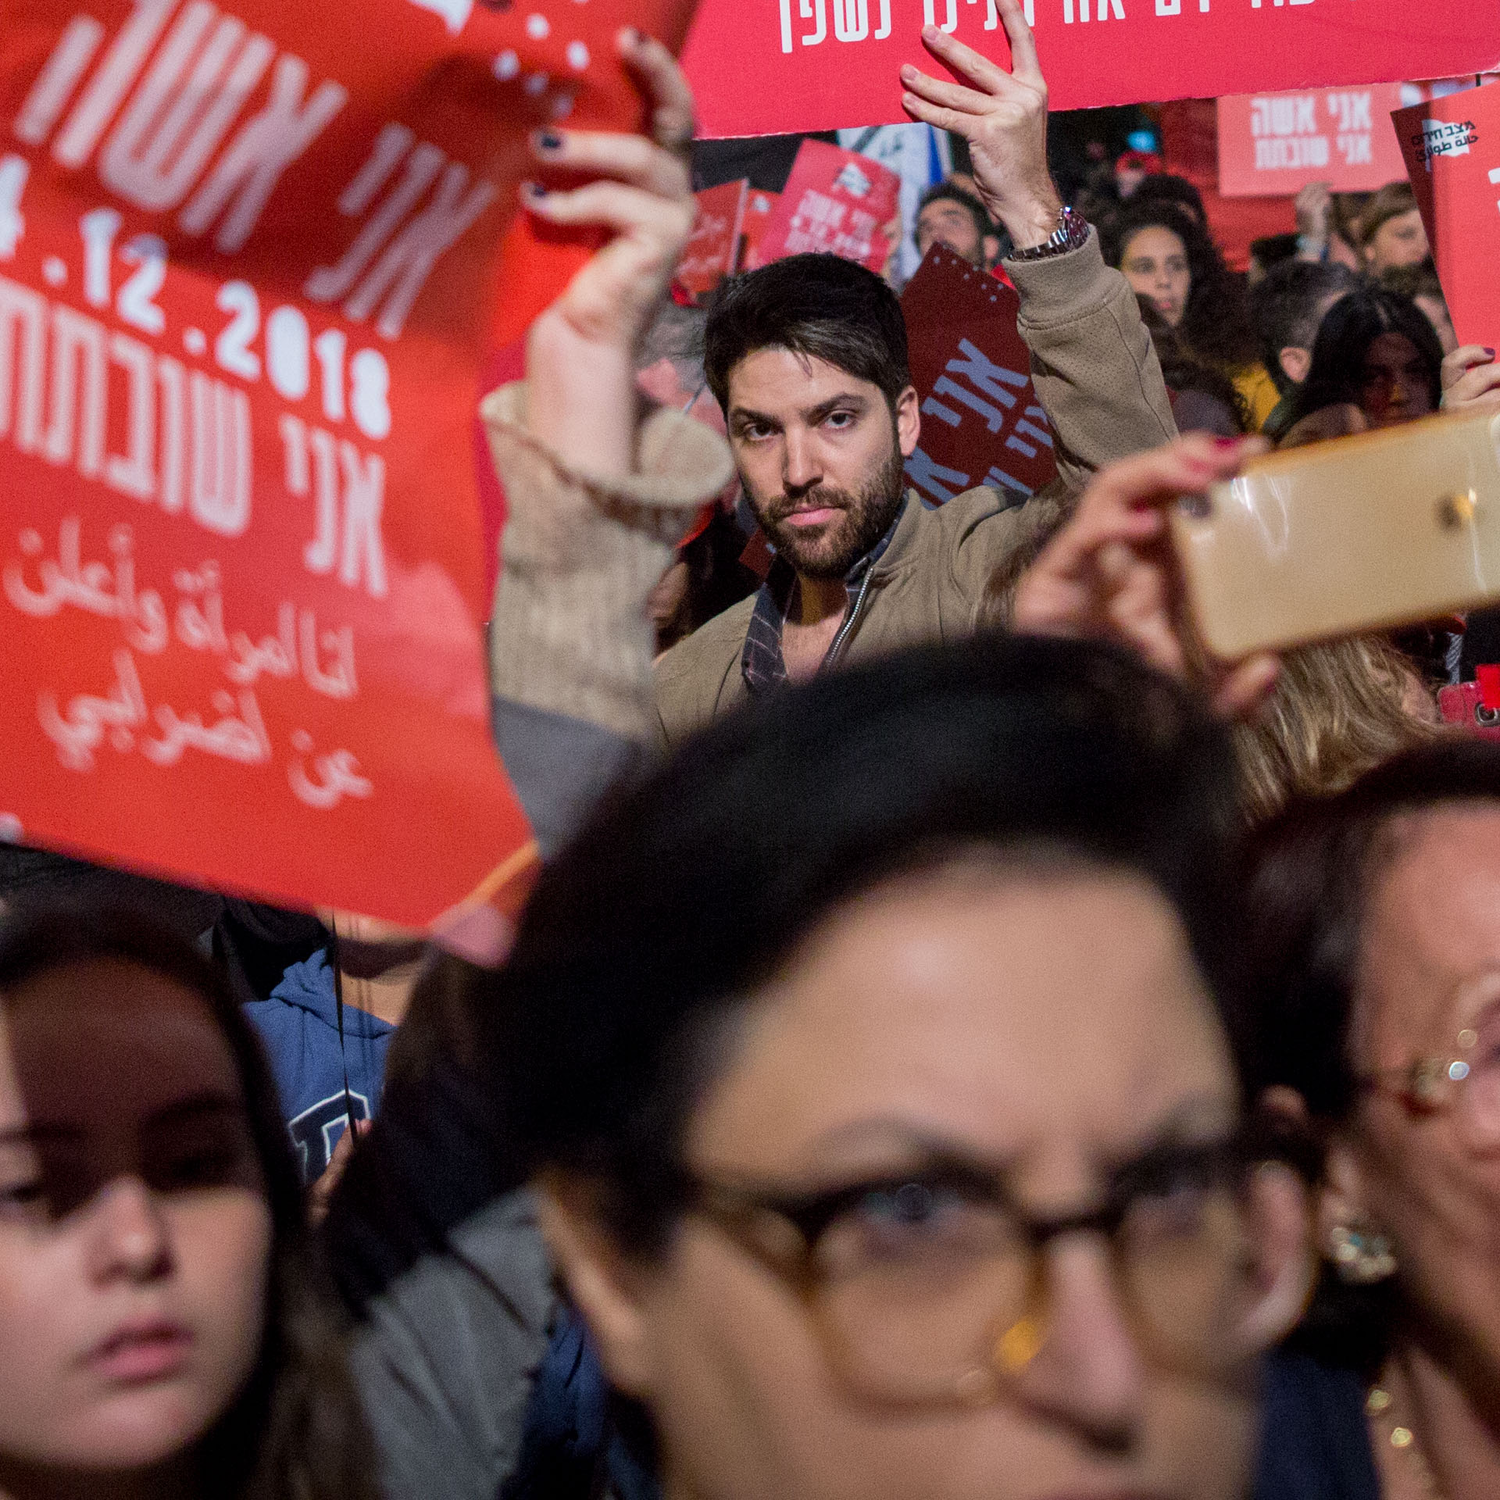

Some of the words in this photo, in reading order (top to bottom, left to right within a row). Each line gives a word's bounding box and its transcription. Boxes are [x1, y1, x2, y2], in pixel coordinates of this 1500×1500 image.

[1251, 96, 1317, 137] אשה
[1327, 91, 1373, 133] אני
[1444, 120, 1476, 137] מצב
[304, 120, 498, 340] אני
[921, 337, 1030, 434] אני
[278, 414, 389, 598] אני
[286, 727, 375, 810] عن
